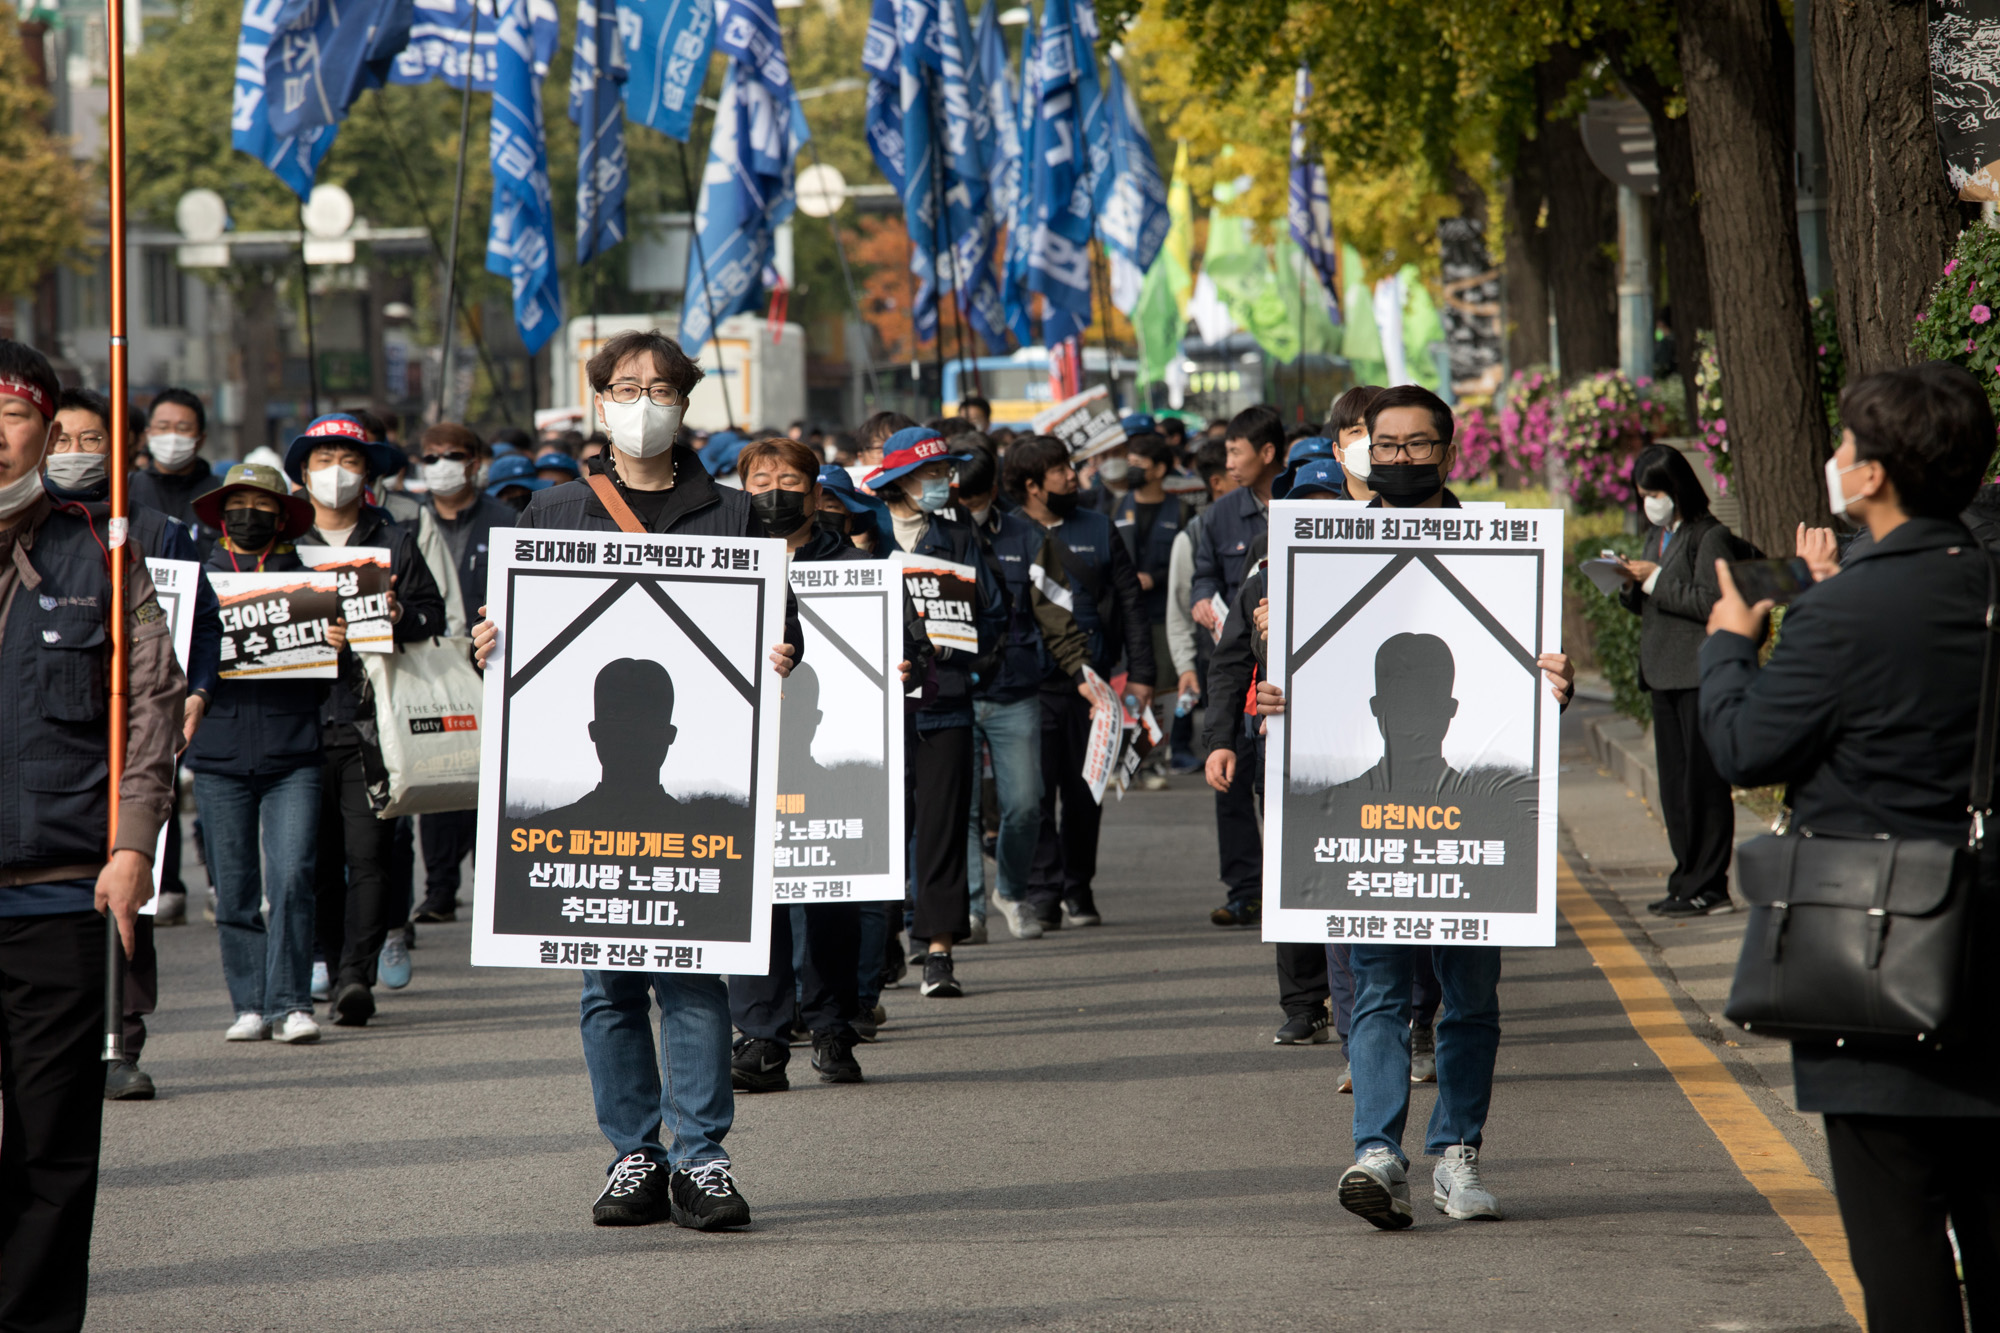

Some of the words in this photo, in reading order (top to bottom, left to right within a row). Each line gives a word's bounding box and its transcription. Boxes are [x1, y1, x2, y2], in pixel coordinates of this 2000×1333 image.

[1294, 518, 1375, 540] 중대재해
[1381, 518, 1483, 541] 최고책임자
[1490, 519, 1538, 542] 처벌!
[514, 540, 597, 565] 중대재해
[603, 542, 705, 568] 최고책임자
[711, 546, 760, 571] 처벌!
[148, 567, 177, 587] 벌!
[844, 569, 883, 586] 처벌!
[219, 598, 290, 632] 더이상
[342, 592, 389, 622] 없다!
[925, 600, 973, 621] 없다!
[243, 631, 269, 655] 수
[405, 705, 430, 715] THE
[432, 703, 474, 713] SHILLA
[412, 721, 442, 732] duty
[447, 717, 474, 729] free
[1361, 804, 1461, 830] 여천NCC
[789, 819, 864, 841] 노동자를
[511, 828, 563, 853] SPC
[569, 830, 685, 858] 파리바게트
[691, 834, 742, 860] SPL
[1313, 838, 1407, 864] 산재사망
[1413, 839, 1505, 866] 노동자를
[529, 863, 623, 891] 산재사망
[628, 866, 721, 893] 노동자를
[775, 882, 807, 899] 진상
[812, 881, 851, 898] 규명!
[1347, 871, 1470, 899] 추모합니다.
[561, 897, 685, 927] 추모합니다.
[1326, 916, 1387, 938] 철저한
[1394, 917, 1434, 939] 진상
[1440, 918, 1489, 941] 규명!
[540, 941, 601, 965] 철저한
[607, 944, 648, 967] 진상
[654, 945, 703, 969] 규명!
